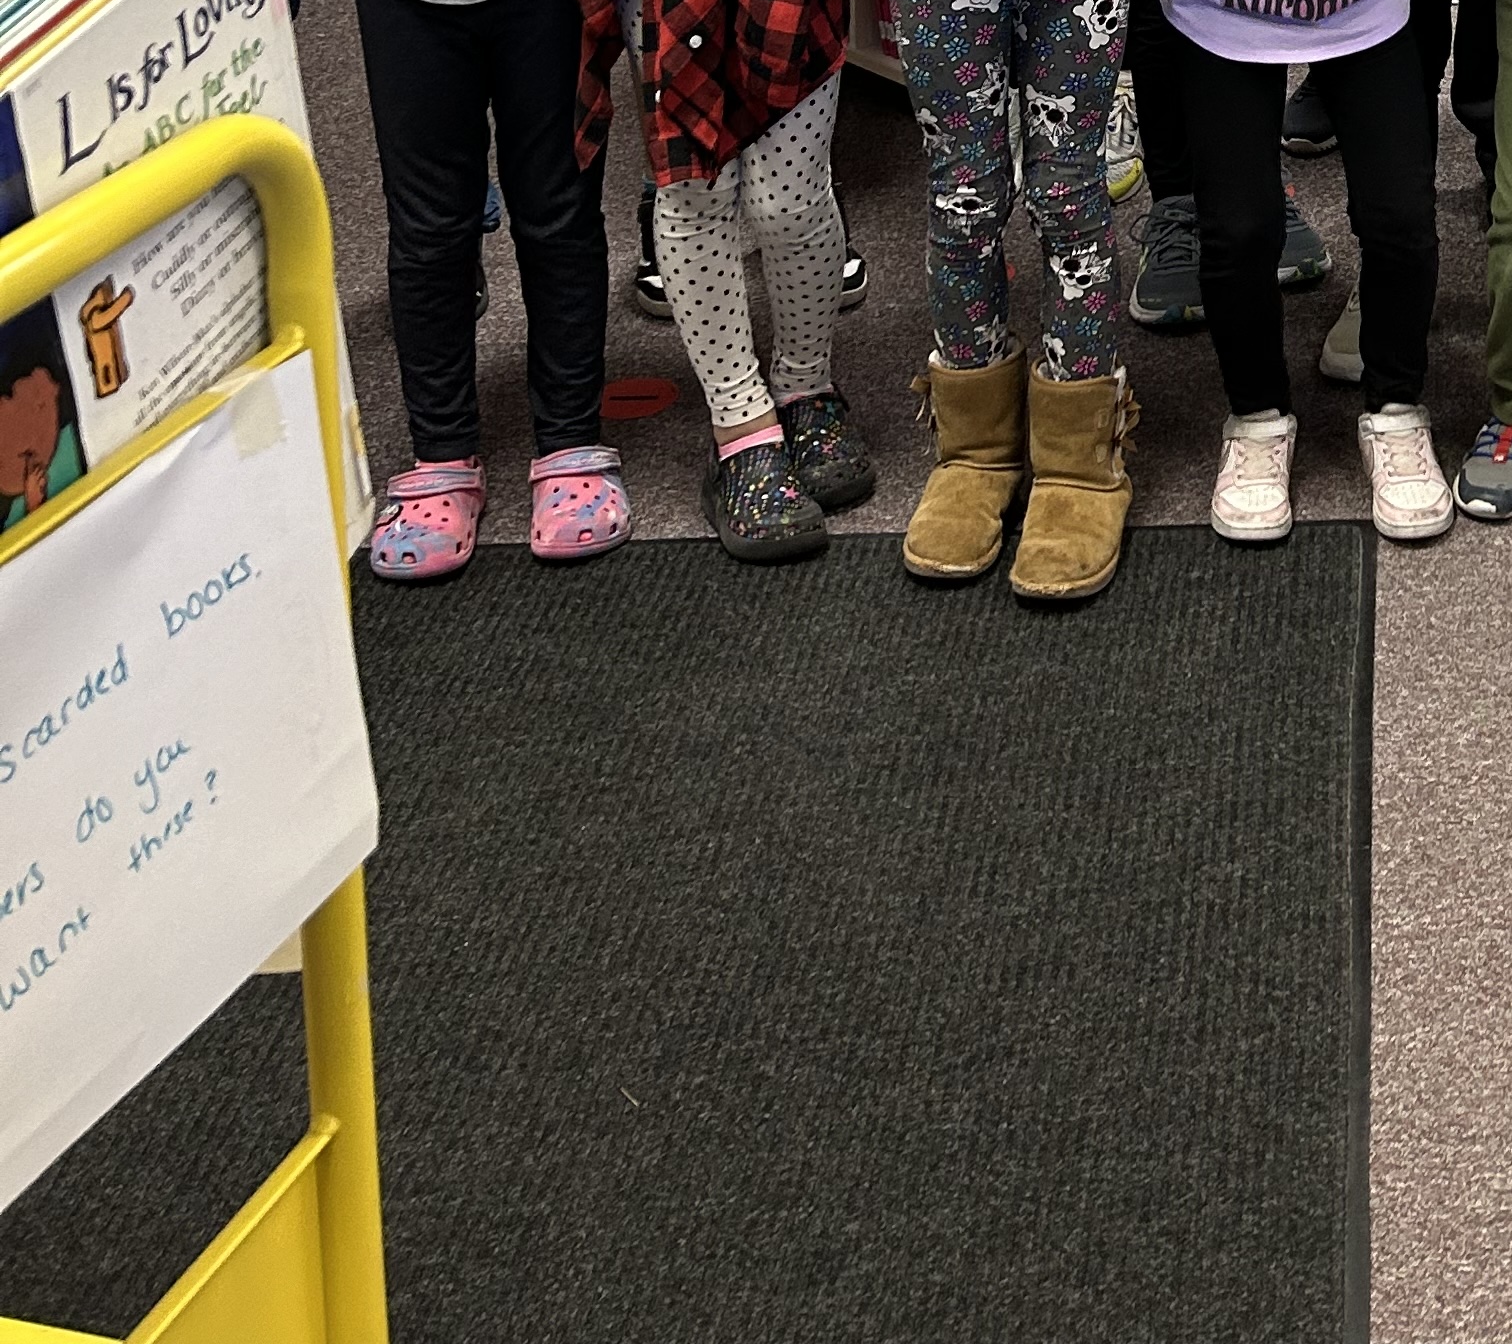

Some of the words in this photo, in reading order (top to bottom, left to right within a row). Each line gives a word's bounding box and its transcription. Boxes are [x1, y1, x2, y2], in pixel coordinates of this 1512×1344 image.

[56, 91, 109, 177] L
[134, 40, 176, 111] for
[142, 91, 195, 156] ABC
[196, 66, 230, 124] for
[229, 35, 267, 77] the
[0, 643, 129, 784] scarded
[161, 553, 262, 639] books.
[76, 795, 114, 844] do
[134, 740, 192, 814] you
